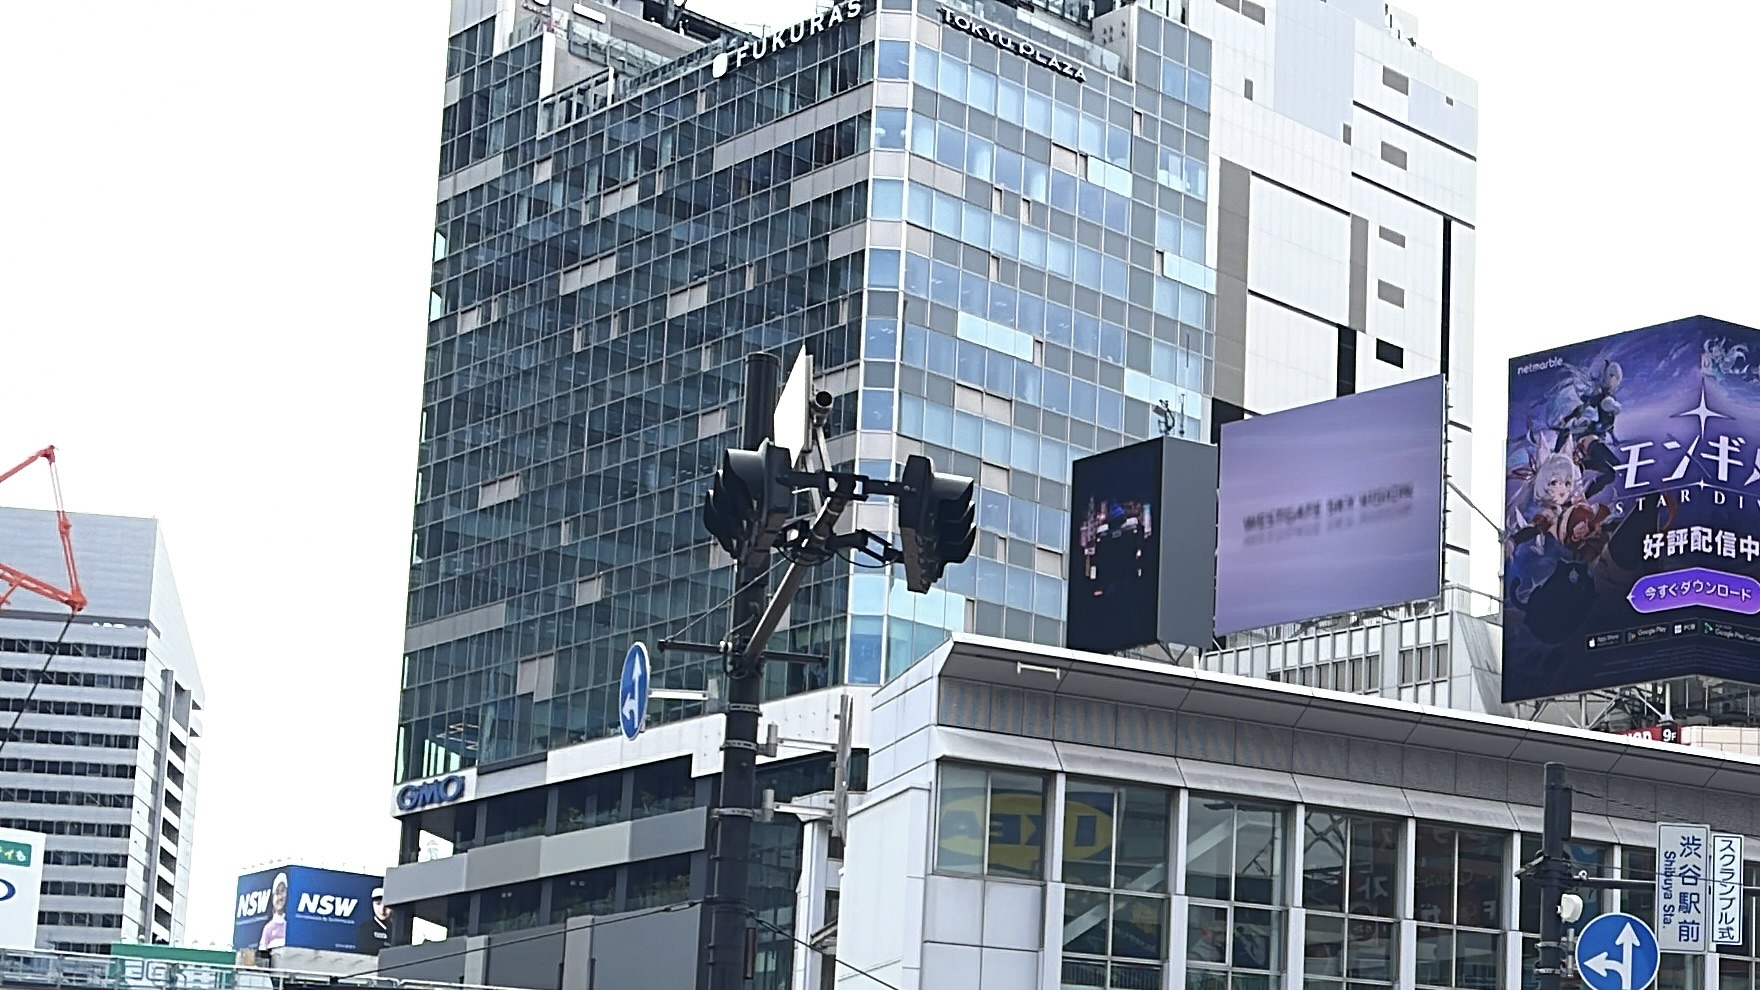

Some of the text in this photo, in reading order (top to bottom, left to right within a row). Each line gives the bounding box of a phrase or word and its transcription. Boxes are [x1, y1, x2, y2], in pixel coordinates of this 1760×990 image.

[736, 0, 862, 67] FUKURAS
[941, 7, 1088, 82] TOKYU PLAZA
[1517, 356, 1563, 375] netmarble
[1616, 489, 1690, 515] STAR
[1643, 526, 1760, 562] 好評配信中
[1645, 579, 1752, 602] 今すぐダウンロード
[1662, 727, 1677, 743] 9F
[397, 775, 465, 811] GMO
[237, 889, 271, 918] NSW
[298, 893, 358, 918] NSW
[1661, 850, 1677, 929] Shibuya Sta.
[1678, 835, 1702, 943] 渋谷駅前
[1718, 839, 1736, 941] スクランブル式
